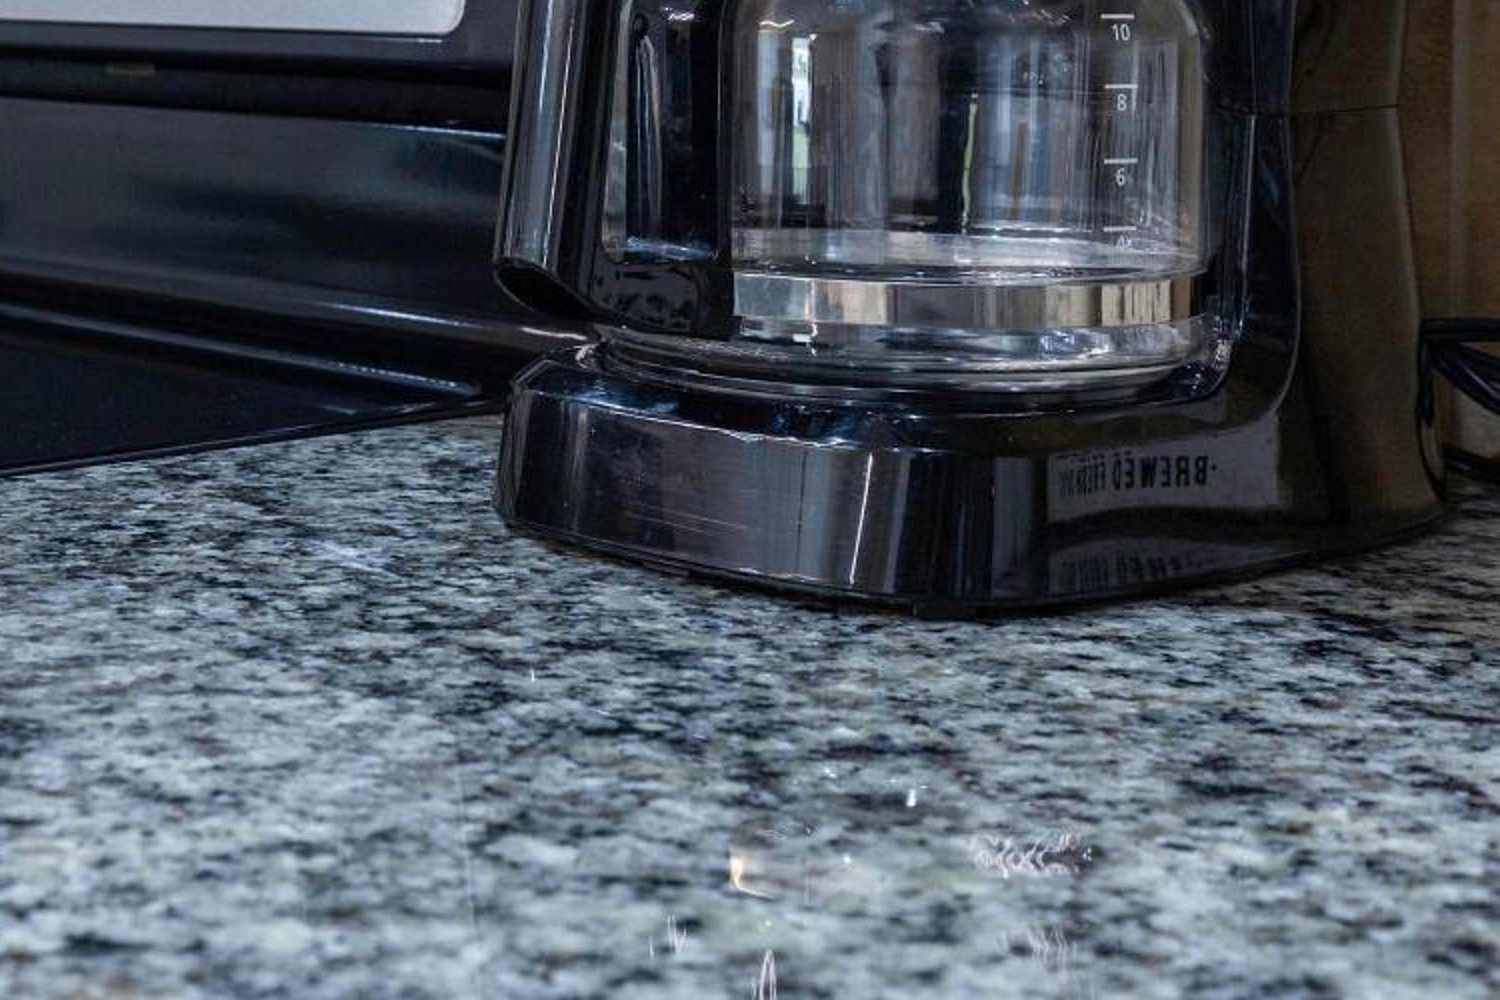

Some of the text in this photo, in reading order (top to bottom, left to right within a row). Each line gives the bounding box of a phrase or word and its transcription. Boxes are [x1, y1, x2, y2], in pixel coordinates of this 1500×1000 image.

[1111, 23, 1131, 42] 10
[1116, 93, 1128, 112] 8
[1115, 168, 1126, 186] 6
